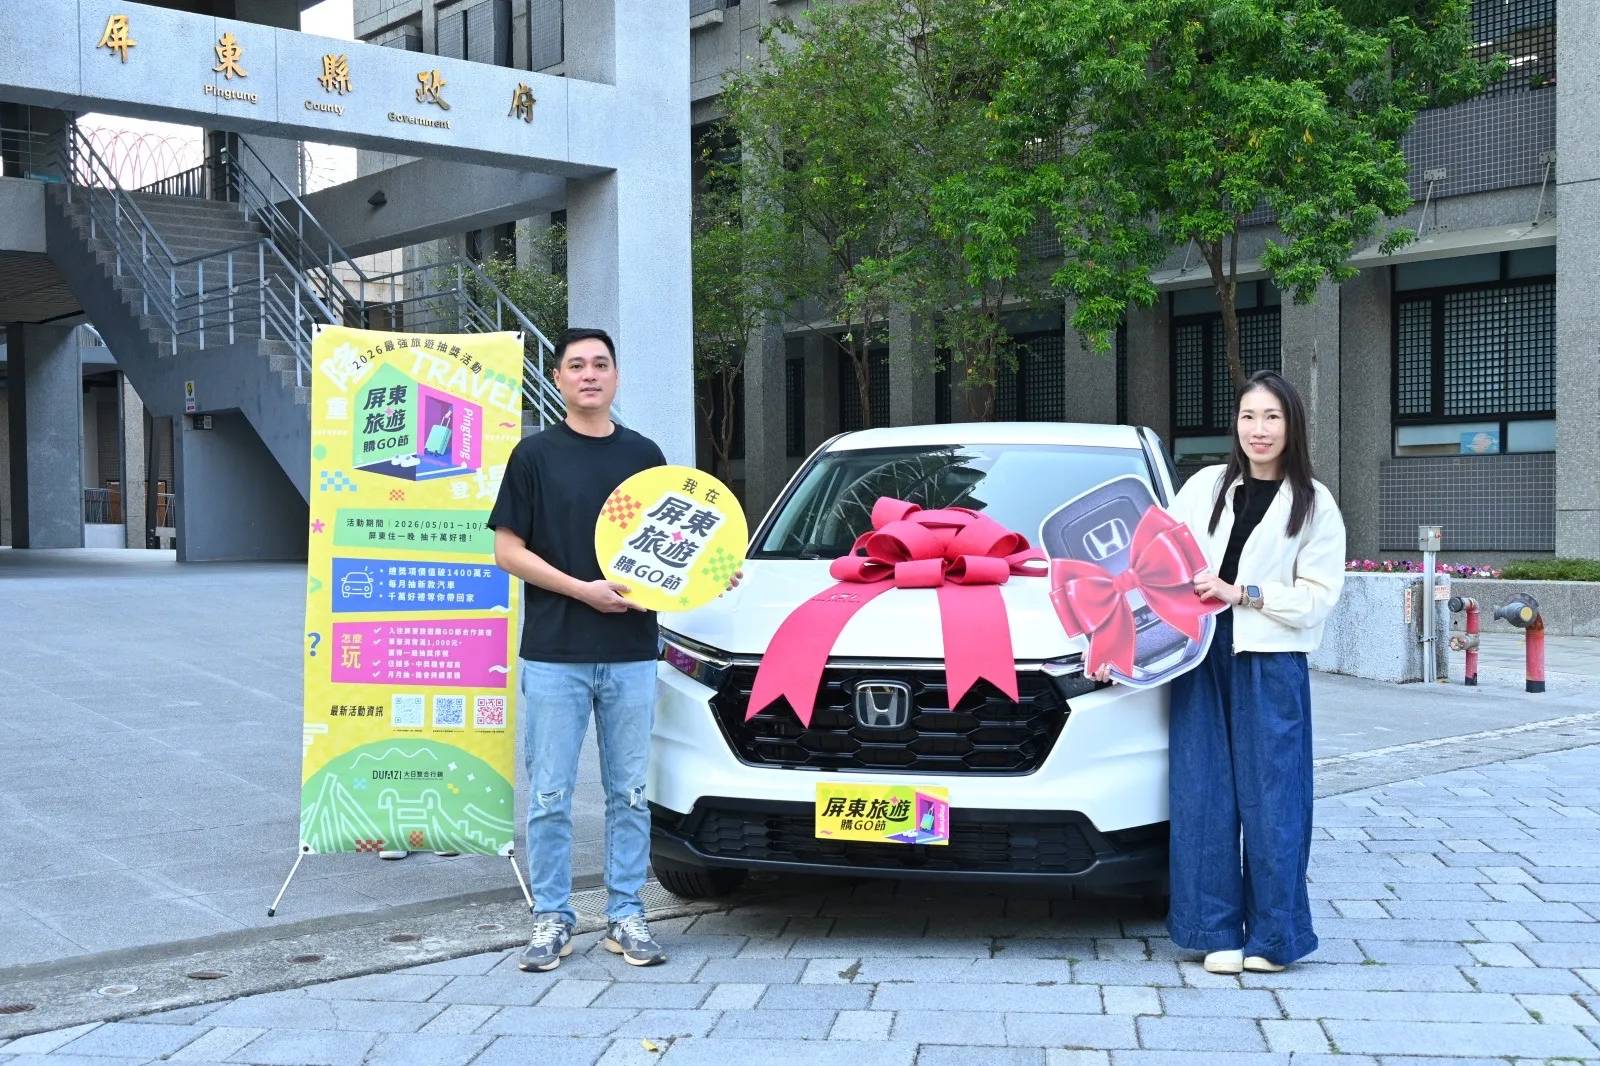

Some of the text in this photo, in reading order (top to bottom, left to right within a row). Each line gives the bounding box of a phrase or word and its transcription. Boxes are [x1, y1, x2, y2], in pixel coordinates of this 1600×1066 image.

[98, 14, 537, 125] 屏東縣政府
[204, 84, 452, 130] Pingtung County Government
[352, 337, 482, 375] 2026最強旅遊抽獎活動
[363, 385, 408, 411] 屏東
[362, 409, 407, 435] 旅遊
[460, 407, 474, 460] Pingtung
[363, 435, 409, 453] 購GO節
[682, 477, 721, 505] 我在
[346, 518, 384, 528] 活動期間
[647, 496, 721, 538] 屏東
[368, 531, 415, 541] 屏東住一晚
[628, 525, 700, 569] 旅遊
[388, 579, 455, 589] 每月抽新款汽車
[613, 555, 684, 591] 購GO節
[388, 591, 475, 602] 千萬好禮等你帶回家
[341, 645, 361, 668] 玩
[330, 705, 384, 717] 最新活動資訊
[822, 797, 912, 823] 屏東旅遊
[938, 803, 946, 833] Pingtung
[840, 819, 887, 831] 購GO節
